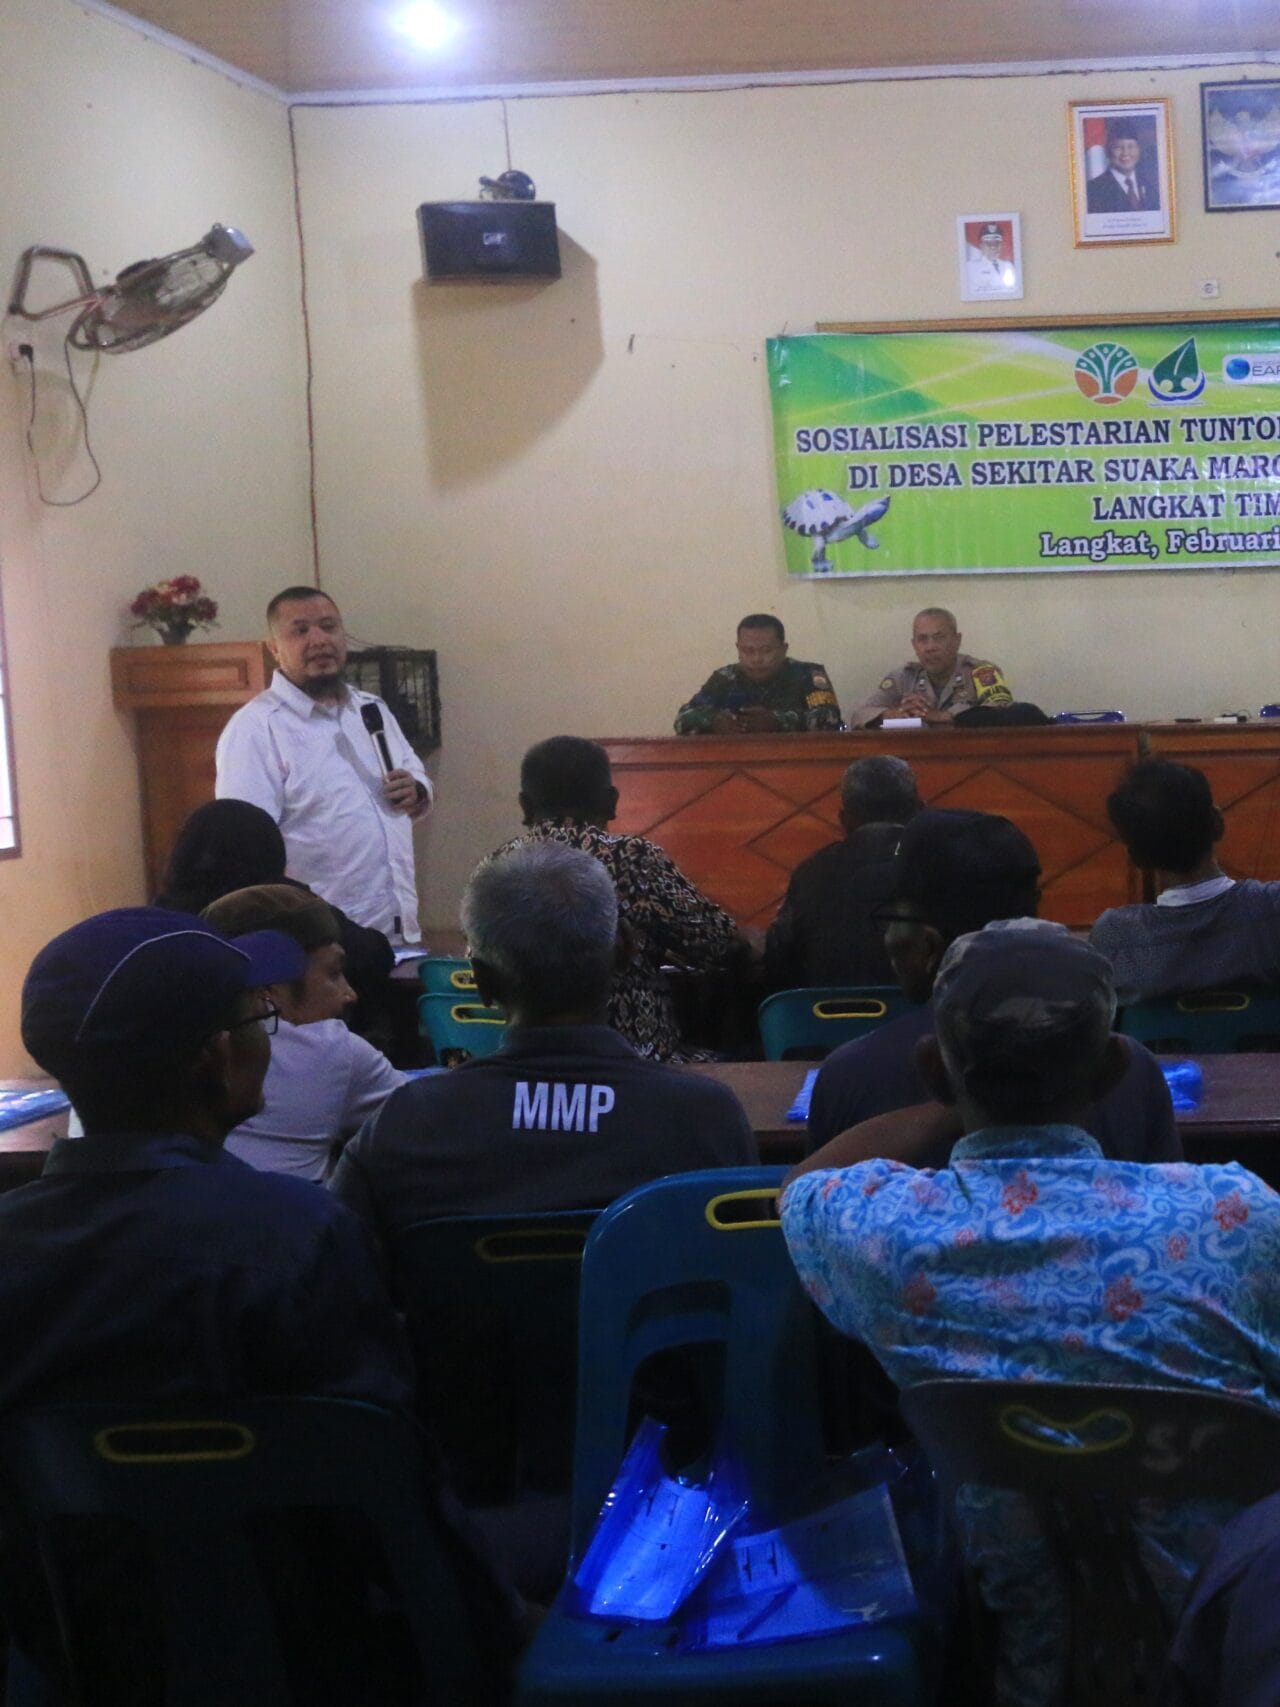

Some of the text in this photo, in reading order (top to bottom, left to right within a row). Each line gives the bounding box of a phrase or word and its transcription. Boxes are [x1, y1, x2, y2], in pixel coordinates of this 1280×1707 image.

[795, 424, 969, 453] SOSIALISASI
[977, 419, 1171, 448] PELESTARIAN
[848, 464, 879, 490] DI
[887, 462, 963, 488] DESA
[971, 459, 1096, 486] SEKITAR
[1103, 456, 1200, 483] SUAKA
[1092, 492, 1226, 521] LANGKAT
[1040, 528, 1160, 560] Langkat,
[511, 1081, 616, 1133] MMP
